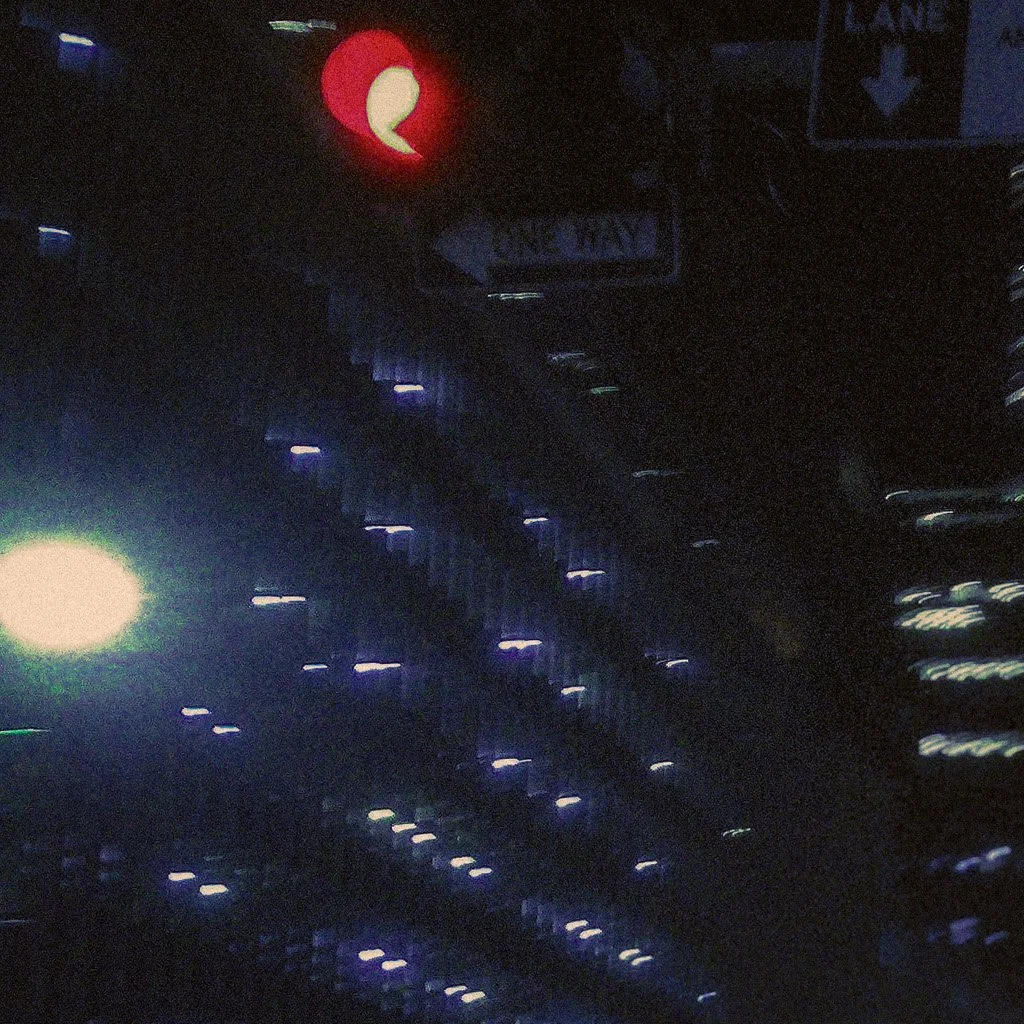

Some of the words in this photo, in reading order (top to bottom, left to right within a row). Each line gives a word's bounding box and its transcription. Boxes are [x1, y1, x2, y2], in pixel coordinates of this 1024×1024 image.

[844, 1, 948, 34] LANE
[493, 219, 560, 259] ONE
[574, 214, 645, 255] WAY
